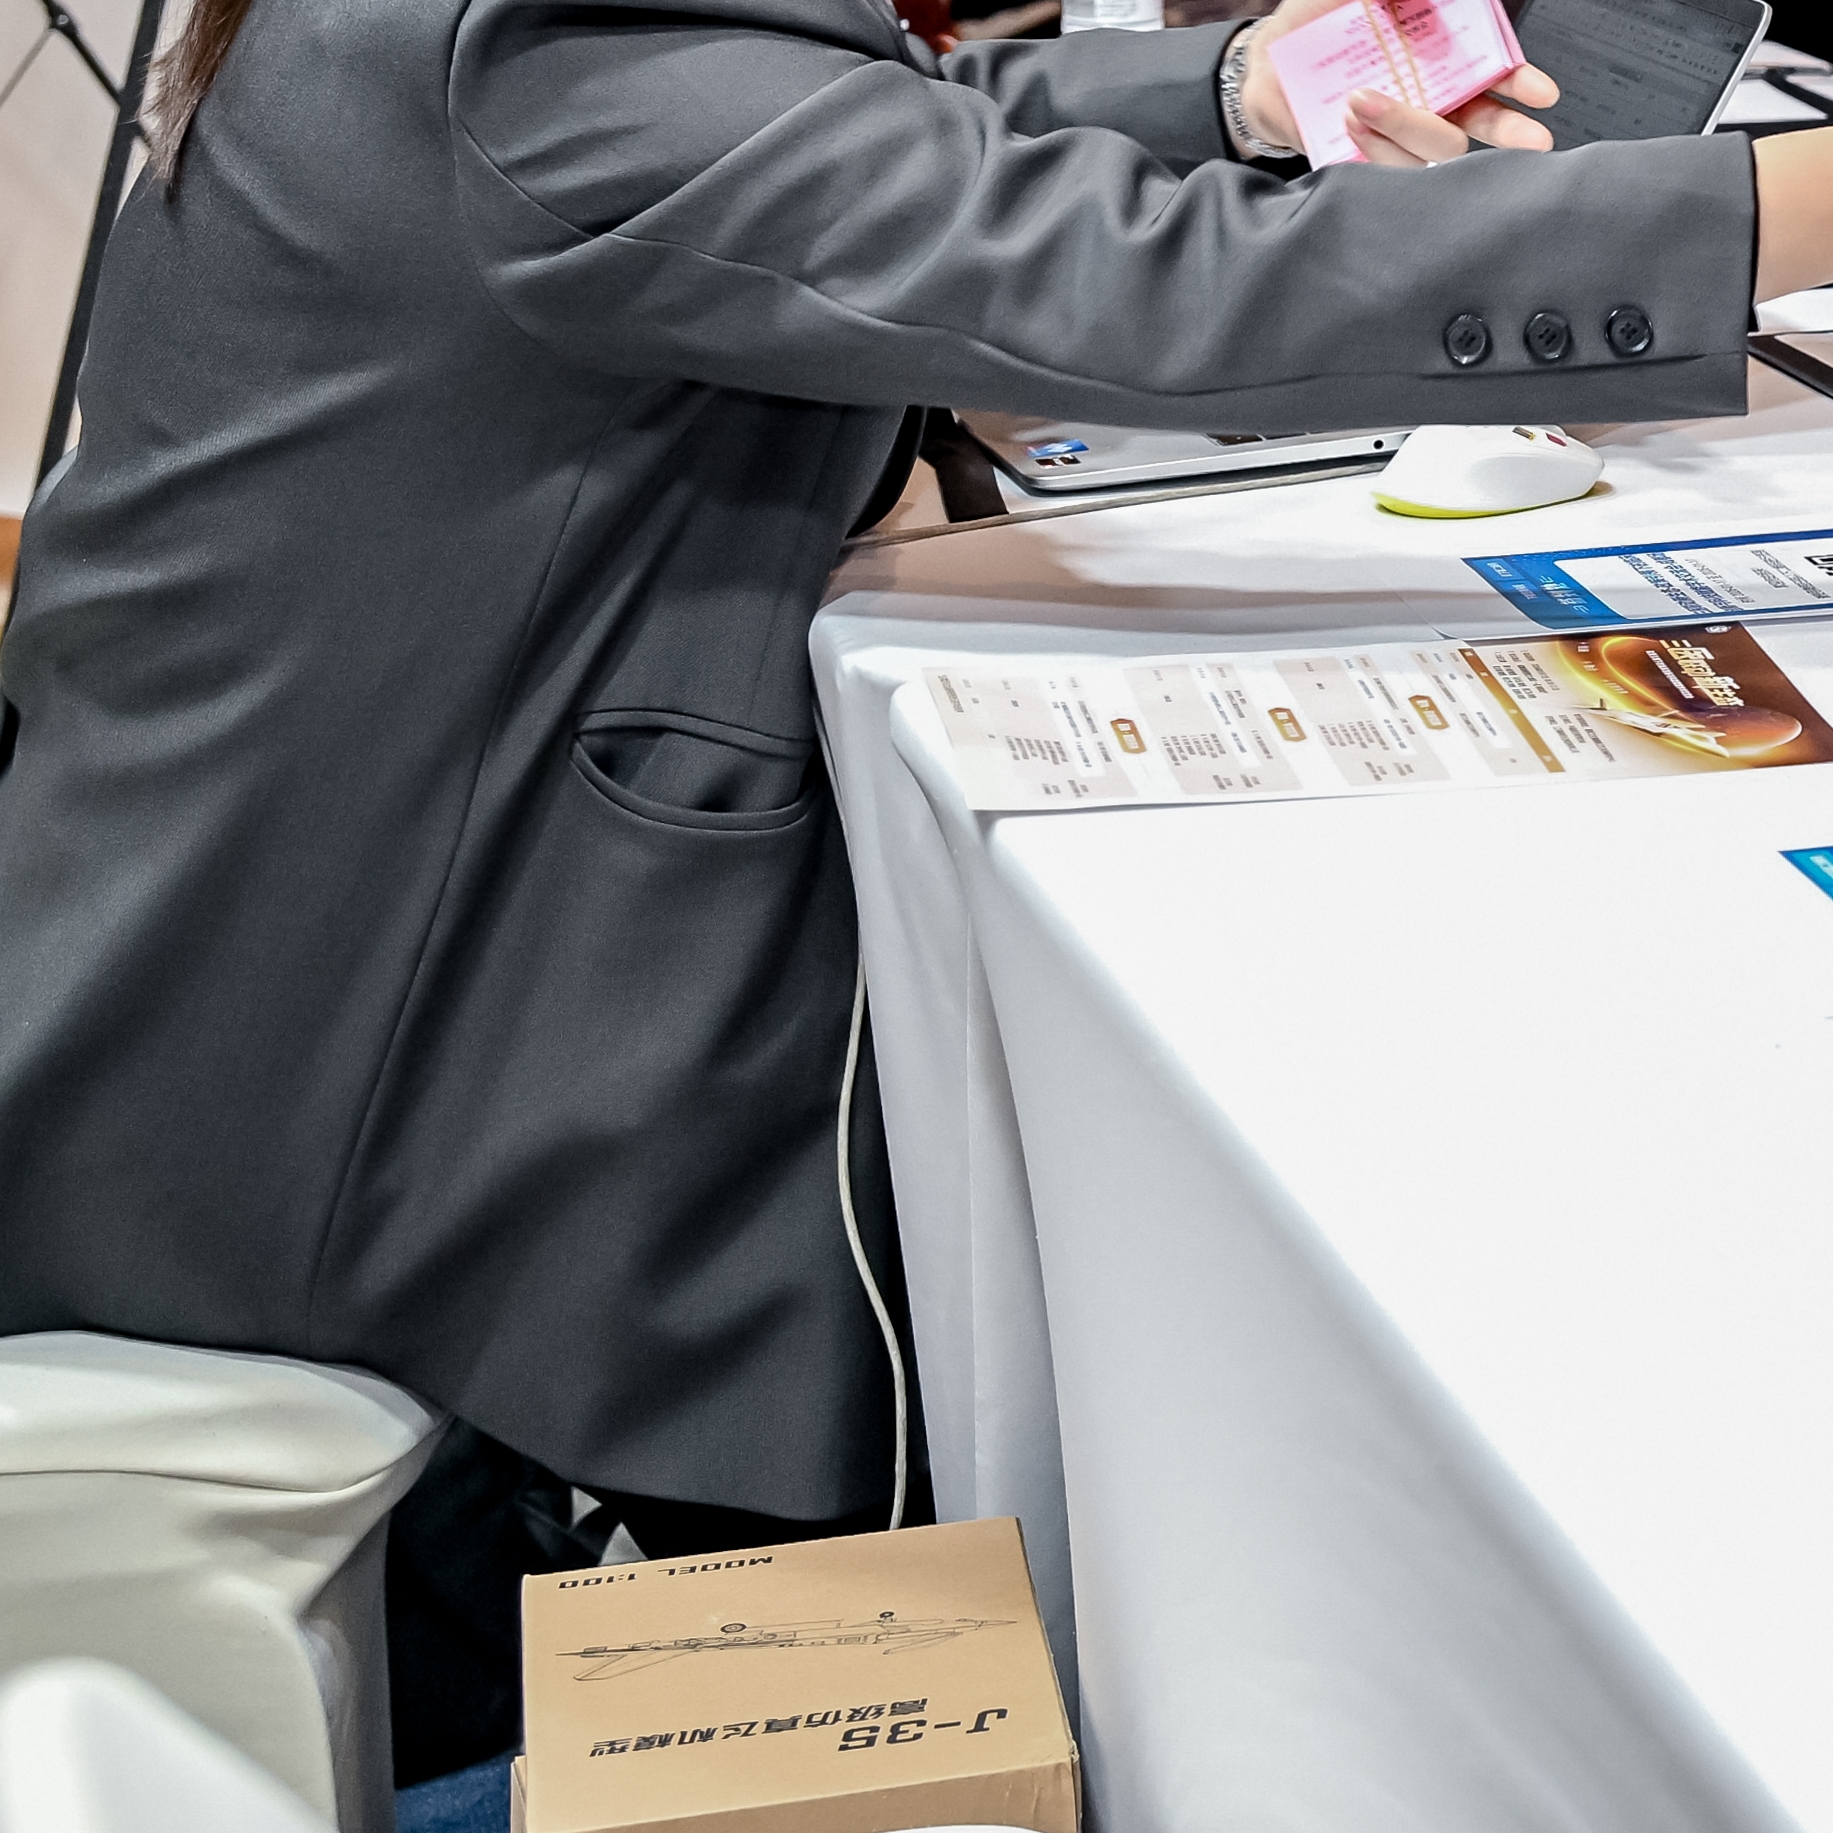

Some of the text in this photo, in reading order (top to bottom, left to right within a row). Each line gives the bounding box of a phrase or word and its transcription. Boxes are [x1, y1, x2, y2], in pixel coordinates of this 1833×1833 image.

[558, 1555, 774, 1590] MODEL 1:100
[588, 1697, 929, 1758] 高级仿真飞机模型
[837, 1707, 1010, 1752] J-35
